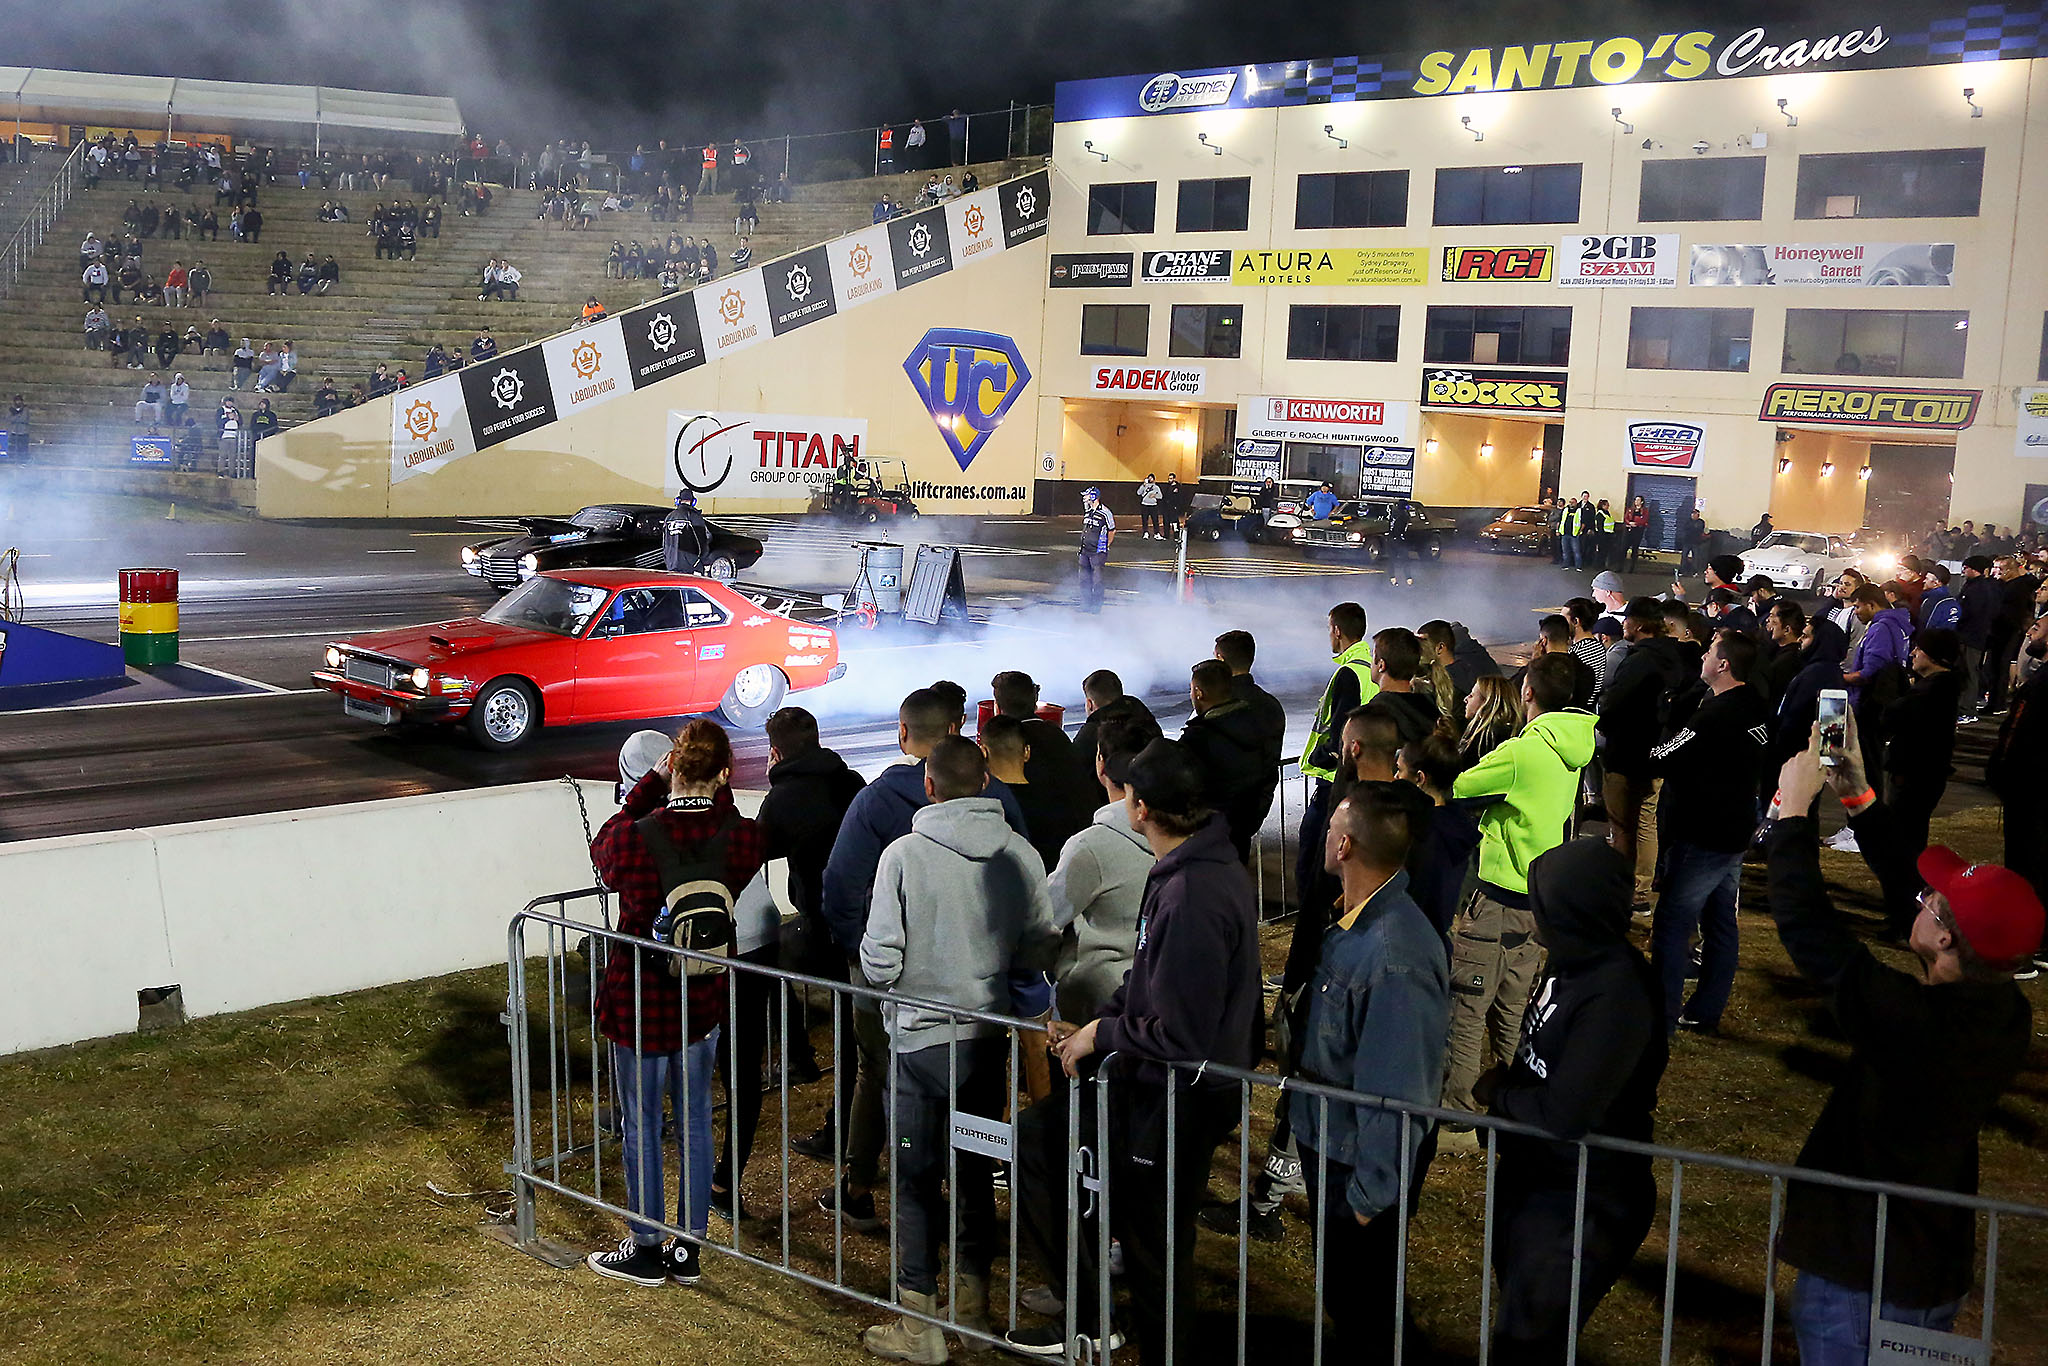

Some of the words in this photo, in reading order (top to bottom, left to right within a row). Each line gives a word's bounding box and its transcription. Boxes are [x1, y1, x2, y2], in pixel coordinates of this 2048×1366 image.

[1412, 30, 1716, 95] SANTO'S
[1716, 25, 1890, 77] Cranes
[962, 242, 981, 257] LABOUR
[981, 237, 993, 250] KING
[1581, 236, 1657, 260] 2GB
[1774, 246, 1864, 263] Honeywell
[1239, 252, 1334, 271] ATURA
[1581, 262, 1654, 275] 873AM
[1821, 264, 1863, 277] Garrett
[846, 282, 869, 300] LABOUR
[869, 278, 883, 293] KING
[1259, 275, 1311, 283] HOTELS
[1783, 277, 1862, 285] www.turbobygarrett.com
[779, 314, 788, 324] OUR
[787, 309, 801, 321] PEOPLE
[800, 304, 812, 317] YOUR
[811, 299, 828, 312] SUCCESS
[717, 330, 742, 349] LABOUR
[742, 324, 758, 341] KING
[640, 366, 650, 377] OUR
[650, 360, 666, 374] PEOPLE
[665, 355, 677, 369] YOUR
[677, 349, 696, 363] SUCCESS
[928, 344, 1007, 433] UC
[1096, 369, 1170, 390] SADEK
[1171, 371, 1200, 381] Motor
[1169, 381, 1199, 394] Group
[570, 383, 598, 405] LABOUR
[598, 377, 616, 395] KING
[1290, 402, 1382, 422] KENWORTH
[1768, 389, 1972, 424] AEROFLOW
[1782, 410, 1832, 418] PERFORMANCE
[482, 425, 493, 436] OUR
[493, 419, 512, 433] PEOPLE
[511, 414, 524, 428] YOUR
[524, 405, 546, 421] SUCCESS
[1252, 429, 1287, 438] GILBERT
[1299, 432, 1329, 440] ROACH
[1331, 434, 1399, 443] HUNTINGWOOD
[403, 445, 436, 468] LABOUR
[436, 438, 455, 456] KING
[753, 431, 859, 468] TITAN
[1045, 459, 1053, 468] 10
[1235, 468, 1262, 477] WITH
[1236, 460, 1280, 469] ADVERTISE
[750, 471, 786, 482] GROUP
[787, 471, 801, 483] OF
[1374, 477, 1412, 486] EXHIBITION
[908, 481, 1026, 500] liftcranes.com.au
[955, 1126, 1008, 1146] FORTRESS
[1880, 1339, 1976, 1366] FORTRESS
